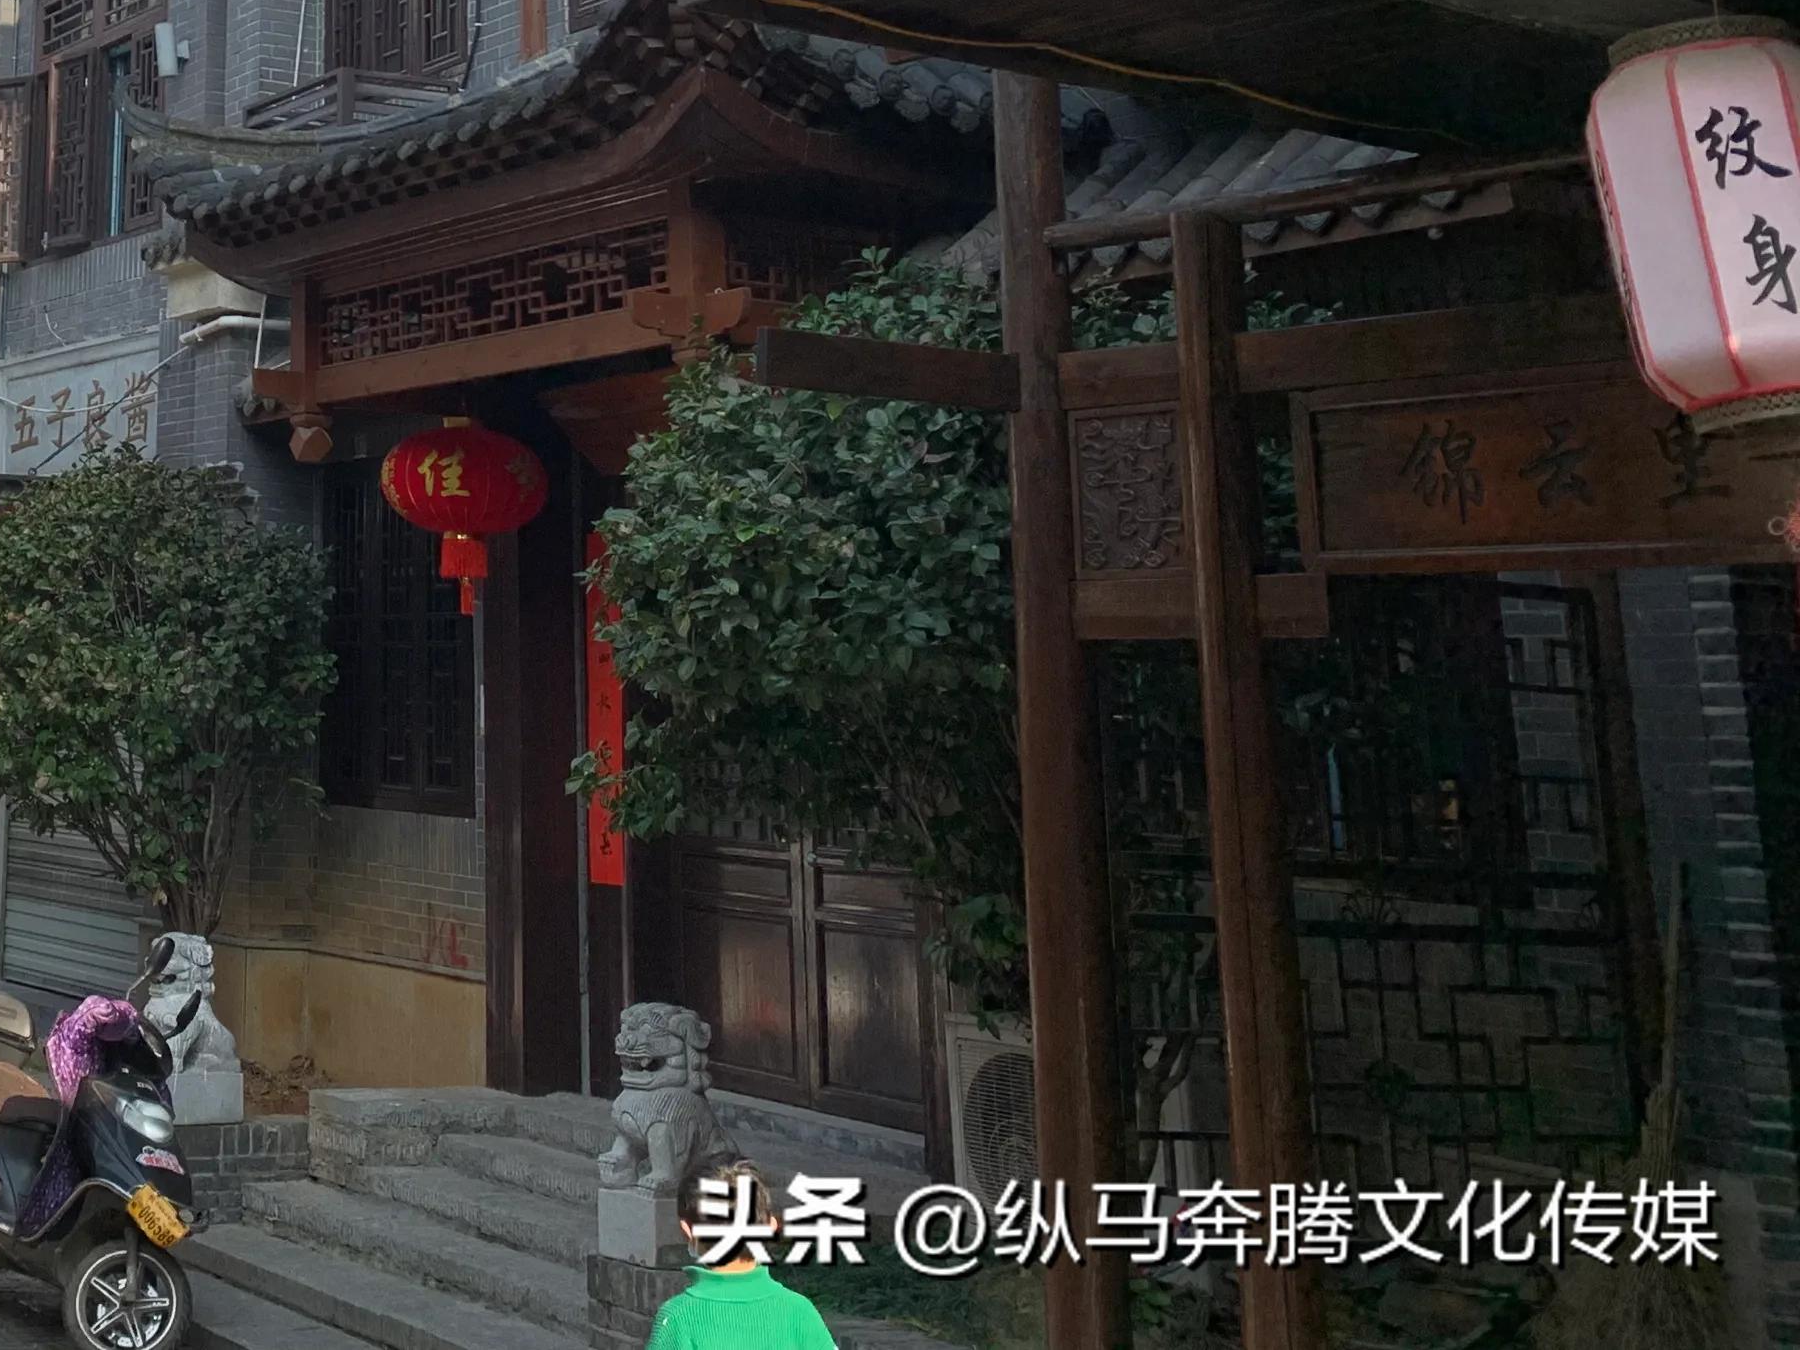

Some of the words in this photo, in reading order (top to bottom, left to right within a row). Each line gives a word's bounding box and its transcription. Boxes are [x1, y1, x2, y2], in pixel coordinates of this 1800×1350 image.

[1695, 106, 1798, 314] 纹身
[417, 447, 472, 498] 佳
[1399, 411, 1736, 525] 锦云里
